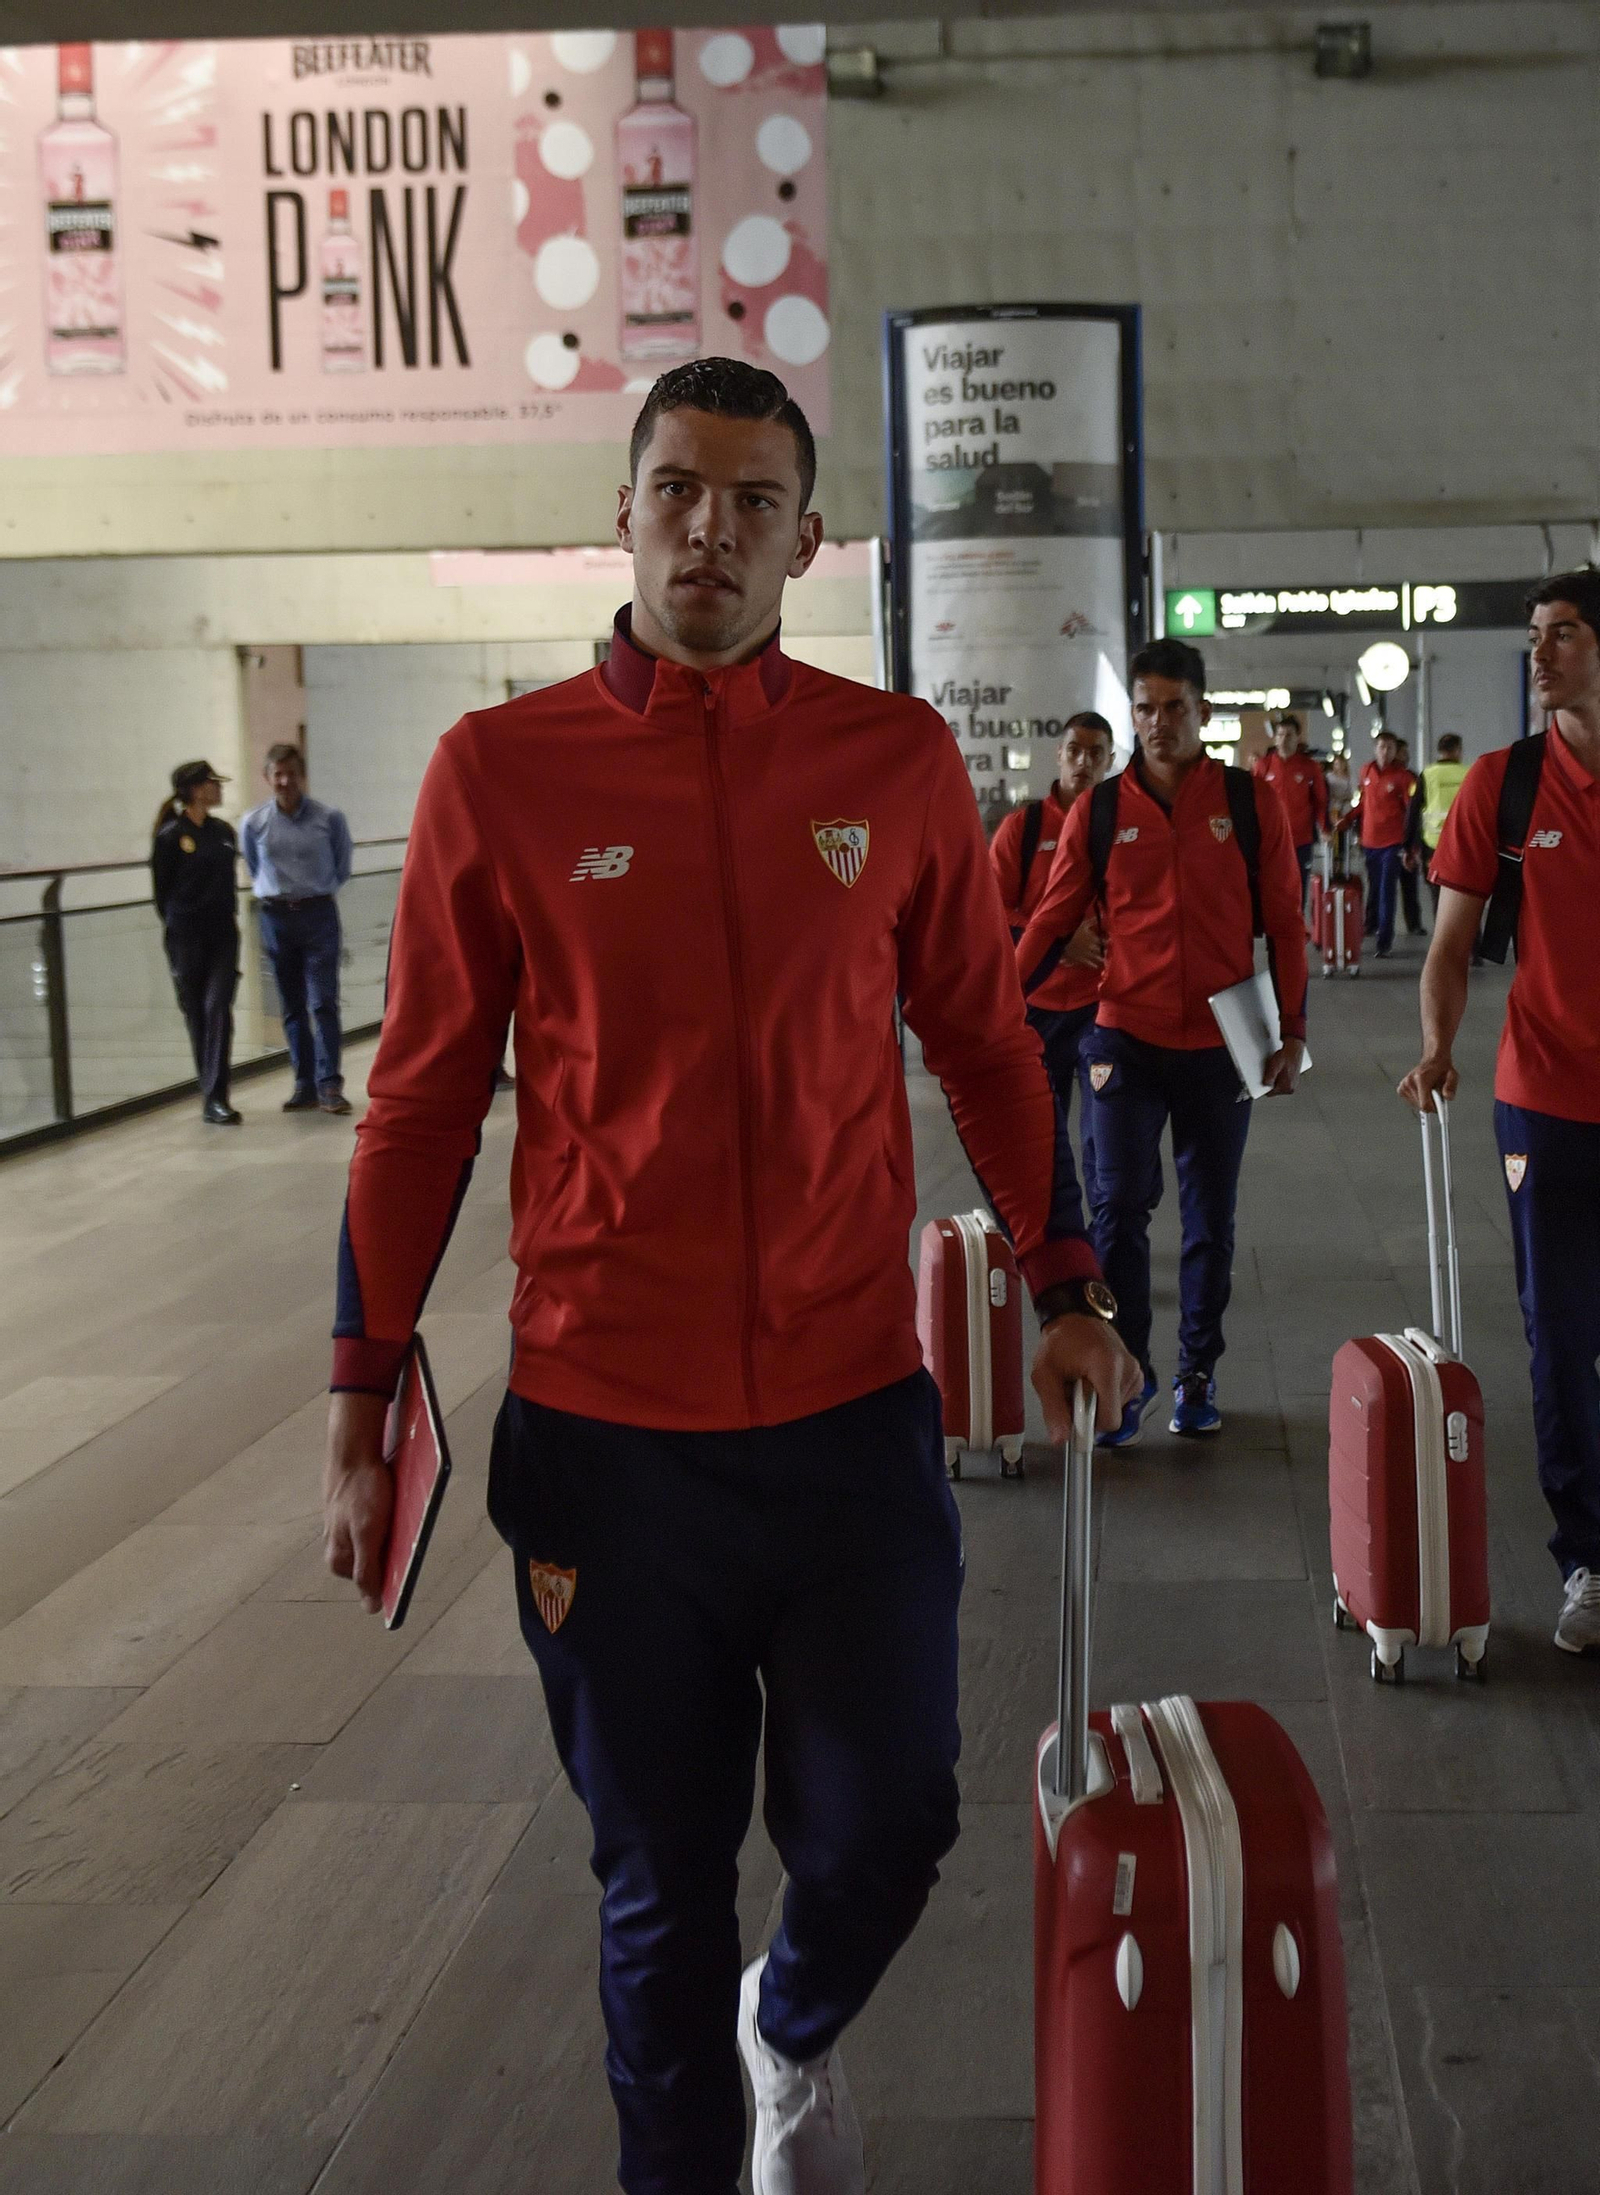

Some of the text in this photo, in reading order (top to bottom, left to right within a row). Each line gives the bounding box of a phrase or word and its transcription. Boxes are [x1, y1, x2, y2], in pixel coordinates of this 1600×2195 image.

[289, 39, 434, 81] BEEFEATER
[262, 105, 468, 178] LONDON
[923, 341, 1004, 376] Viajar
[924, 377, 1057, 405] es bueno
[315, 409, 395, 424] consumo
[925, 408, 1020, 443] para la
[926, 442, 999, 472] salud
[931, 680, 1012, 713] Viajar
[569, 845, 634, 882] NB
